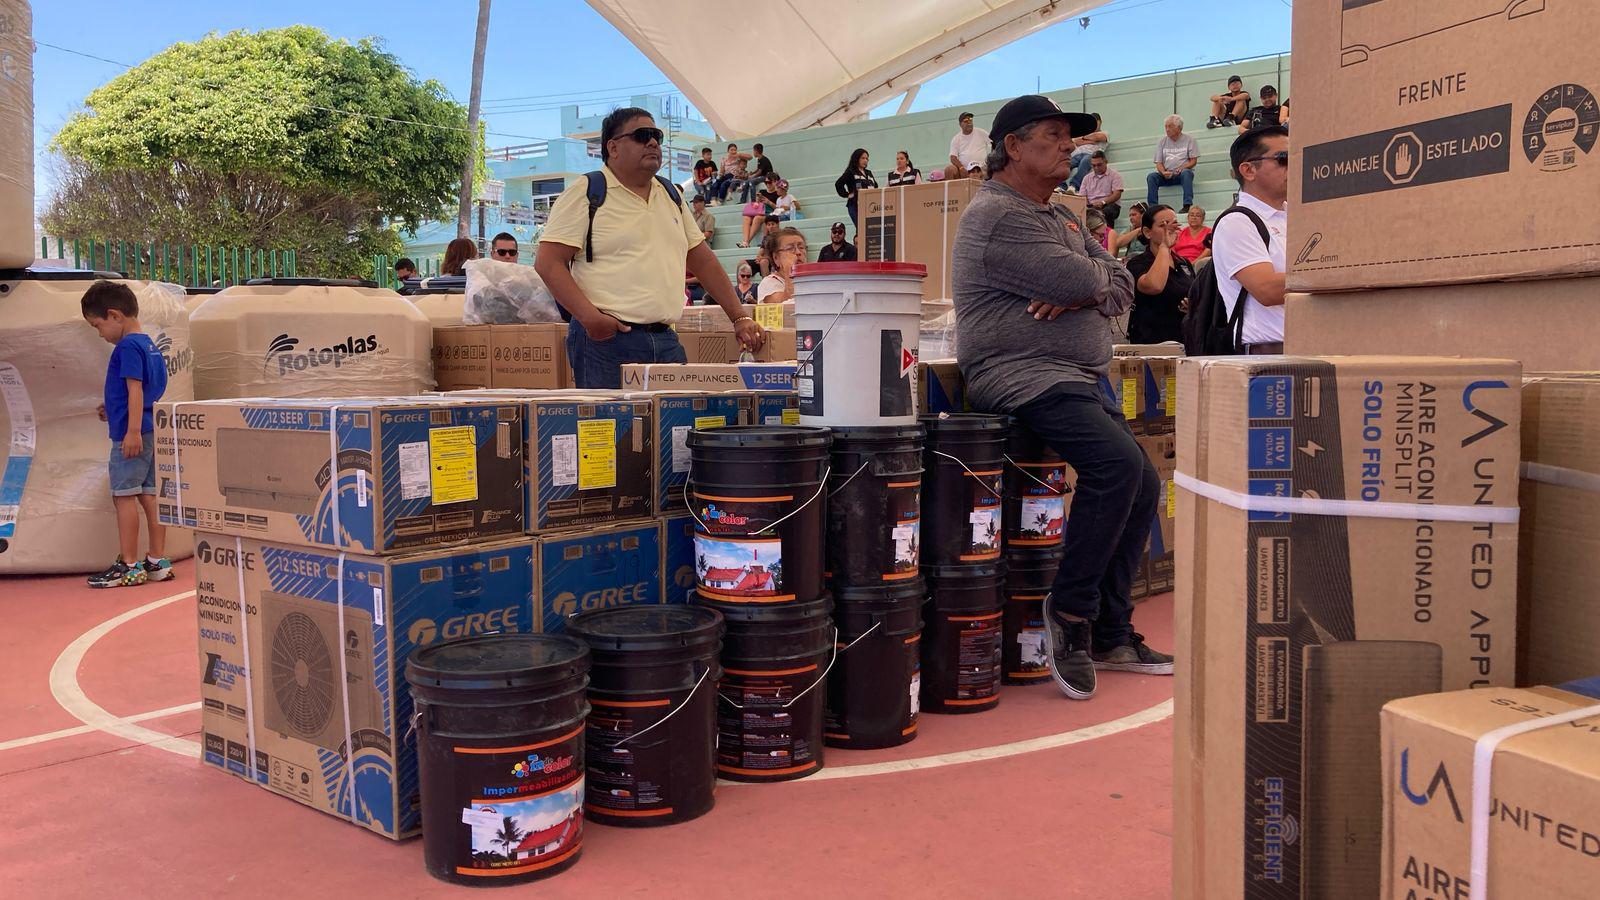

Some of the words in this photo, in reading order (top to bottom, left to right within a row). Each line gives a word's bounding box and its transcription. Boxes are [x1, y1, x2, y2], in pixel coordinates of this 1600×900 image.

[1397, 71, 1468, 106] FRENTE
[1312, 163, 1330, 182] NO
[1333, 153, 1381, 177] MANEJE
[1426, 140, 1458, 161] ESTE
[1461, 131, 1503, 155] LADO
[923, 201, 935, 209] TOP
[935, 199, 959, 208] FREZER
[1320, 254, 1339, 263] 6mm
[278, 333, 378, 371] Rotoplas
[679, 373, 739, 383] APPLIANCES
[752, 373, 763, 385] 12
[763, 374, 792, 385] SEER
[667, 399, 691, 410] GREE
[1275, 378, 1286, 416] 12,000
[1418, 381, 1436, 435] AIRE
[169, 413, 206, 430] GREE
[267, 411, 280, 424] 12
[280, 411, 304, 425] SEER
[393, 413, 426, 423] GREE
[547, 406, 574, 417] GREE
[1362, 380, 1383, 442] SOLO
[157, 436, 168, 445] AIRE
[1265, 432, 1274, 466] VOLTAJE
[1394, 382, 1415, 495] MINISPLIT
[1360, 448, 1385, 502] FRÍO
[718, 513, 747, 526] color
[1413, 439, 1436, 624] ACONICIONADO
[1470, 457, 1495, 590] UNTED
[278, 555, 290, 574] 12
[291, 557, 322, 579] SEER
[1276, 542, 1286, 574] EQUIPO
[199, 580, 216, 594] AIRE
[580, 581, 650, 611] GREE
[1276, 574, 1286, 618] COMPLETO
[199, 594, 258, 616] ACONDICIONDO
[199, 608, 233, 626] MINISPLIT
[200, 627, 220, 641] SOLO
[441, 605, 520, 641] GREE
[543, 754, 574, 774] color
[1254, 778, 1265, 881] SERIES
[1264, 776, 1283, 884] EFFICIENT
